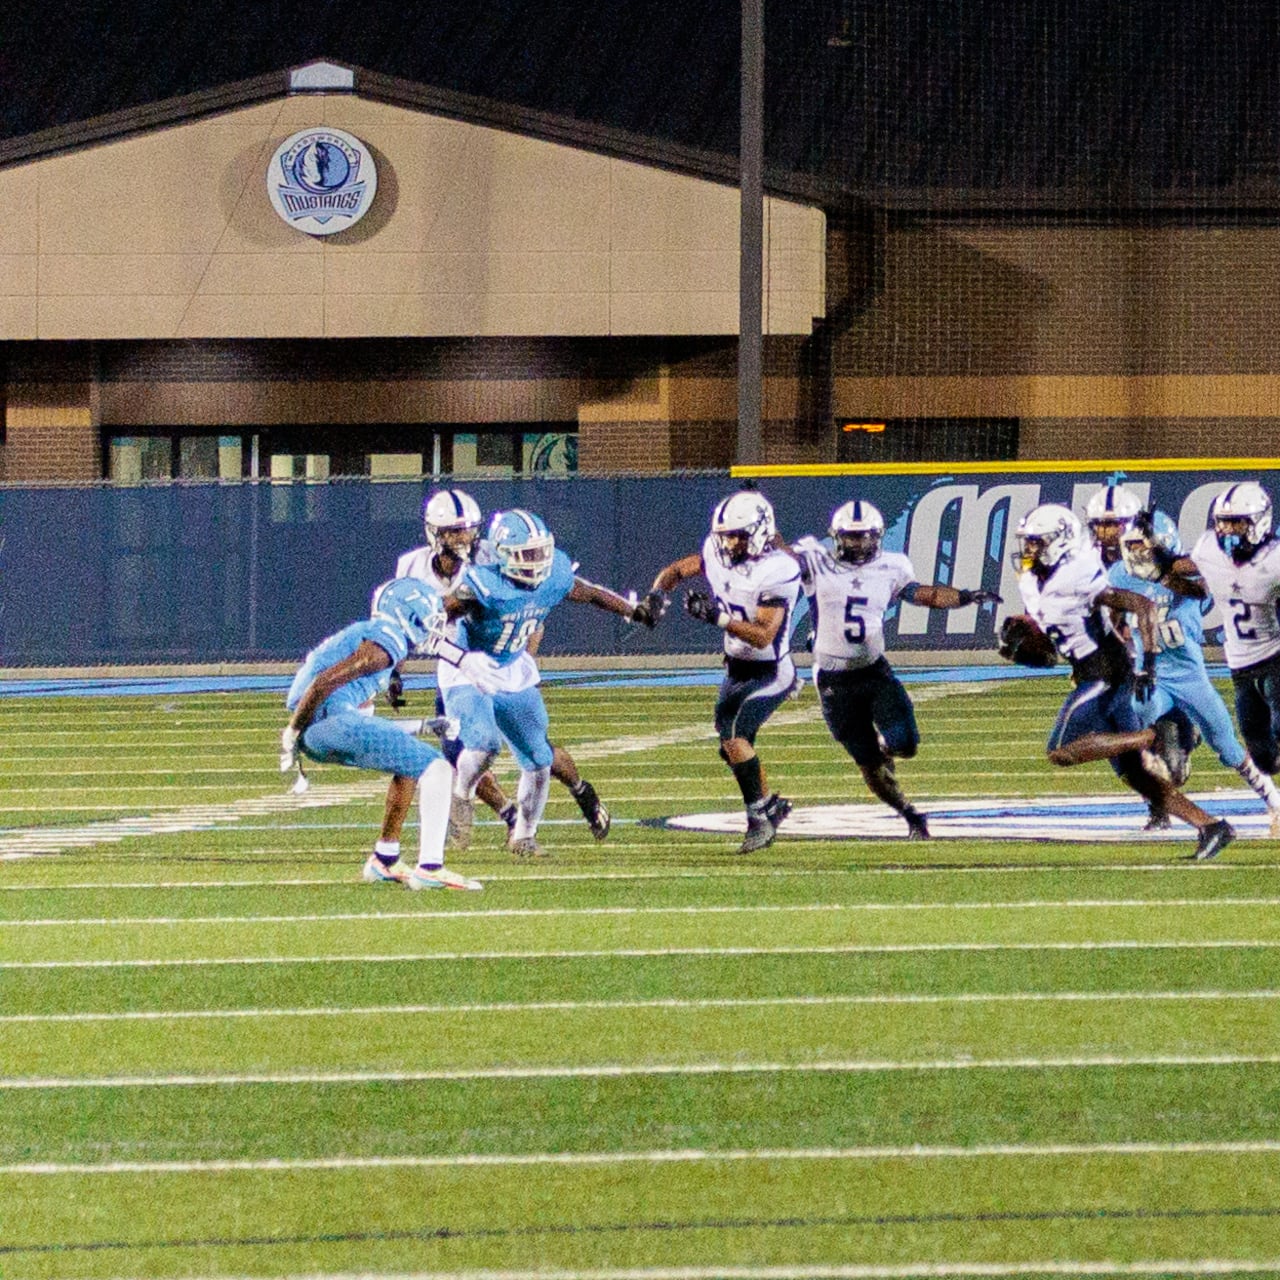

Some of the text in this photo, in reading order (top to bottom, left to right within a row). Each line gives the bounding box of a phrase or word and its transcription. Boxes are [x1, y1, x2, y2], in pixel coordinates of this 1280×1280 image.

[283, 190, 361, 213] MUSTANGS
[844, 595, 868, 644] 5
[1229, 598, 1257, 640] 2
